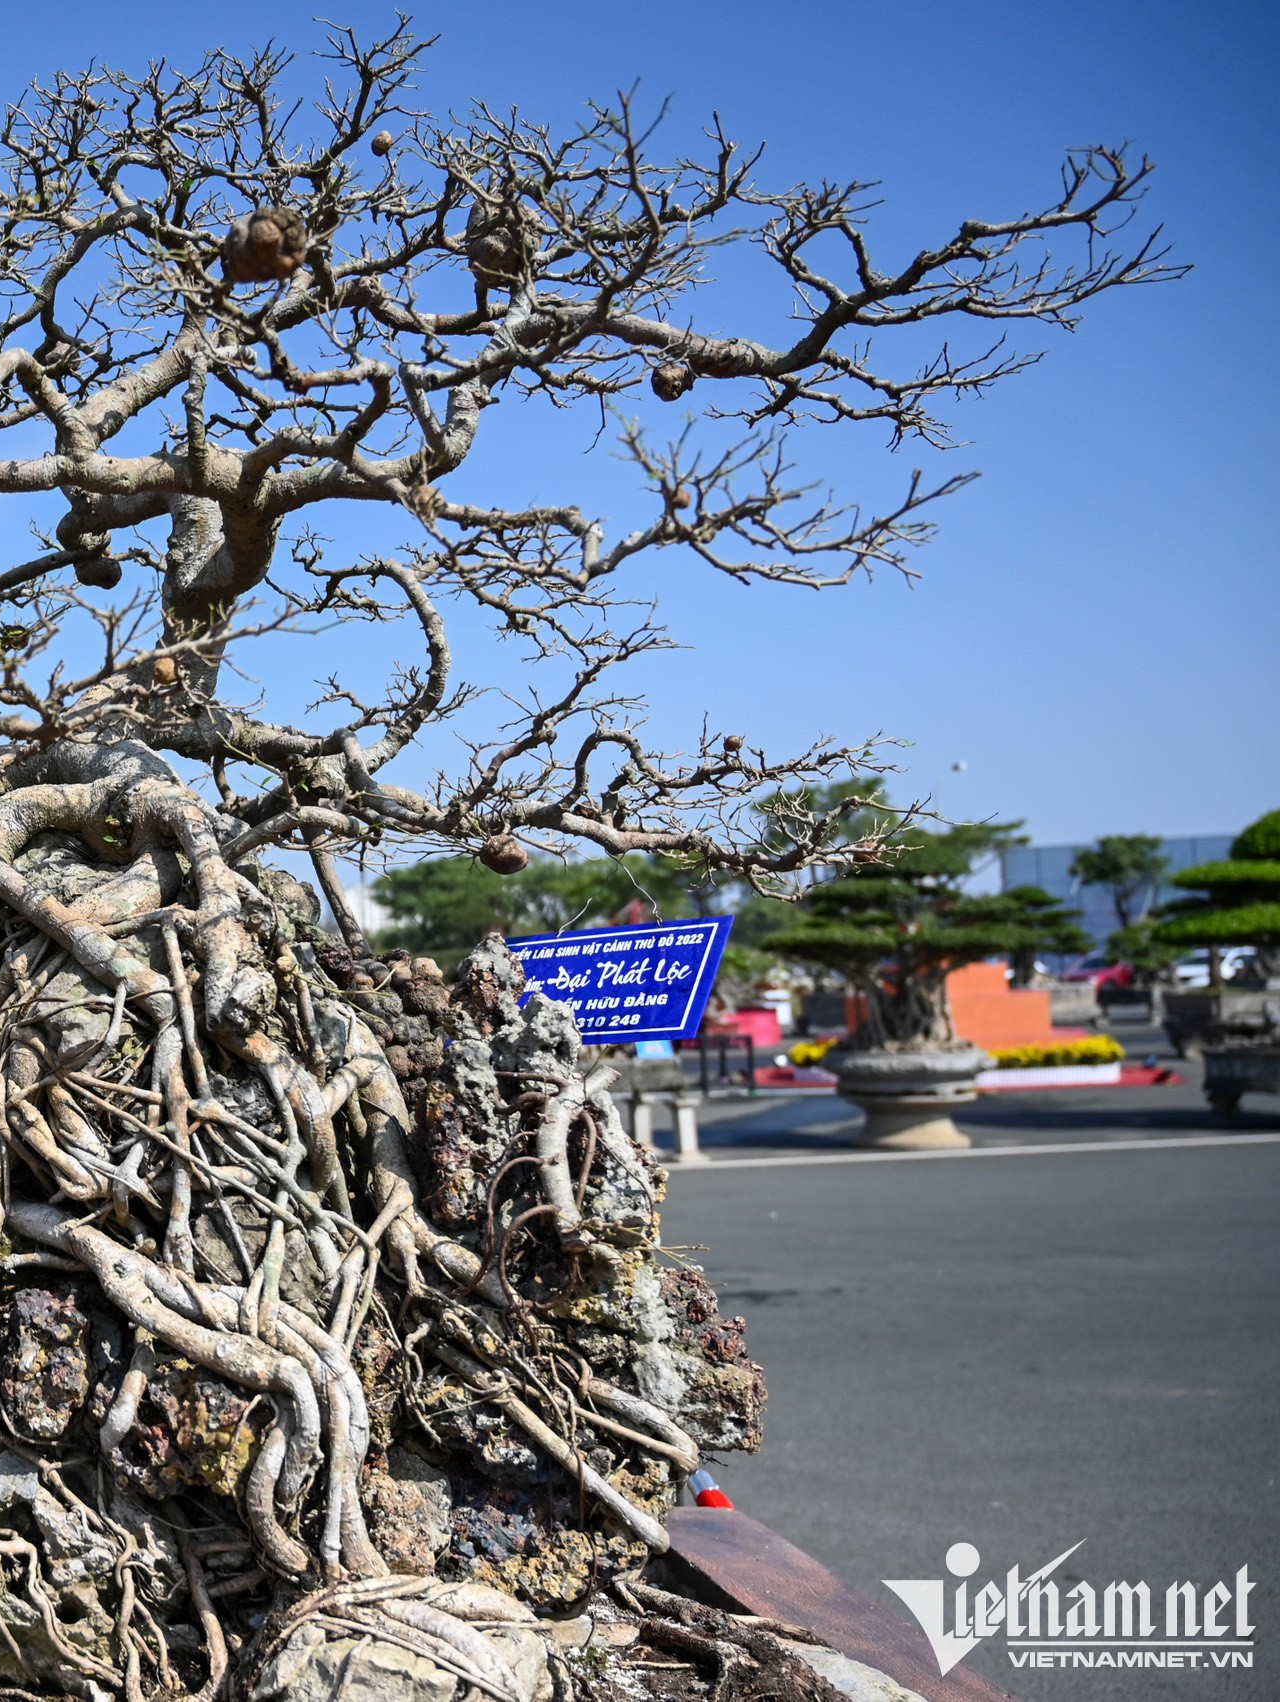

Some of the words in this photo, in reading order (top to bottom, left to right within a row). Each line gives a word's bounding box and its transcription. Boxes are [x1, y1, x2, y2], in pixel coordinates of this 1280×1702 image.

[555, 945, 581, 958] SINH
[582, 941, 602, 956] VẬT
[602, 939, 632, 953] CẢNH
[634, 935, 655, 950] THỦ
[657, 933, 674, 947] ĐÔ
[675, 933, 704, 945] 2022
[547, 965, 591, 993] Đại
[596, 957, 652, 989] Phát
[654, 958, 692, 985] Lộc
[585, 996, 621, 1010] HỮU
[608, 1013, 641, 1027] 248
